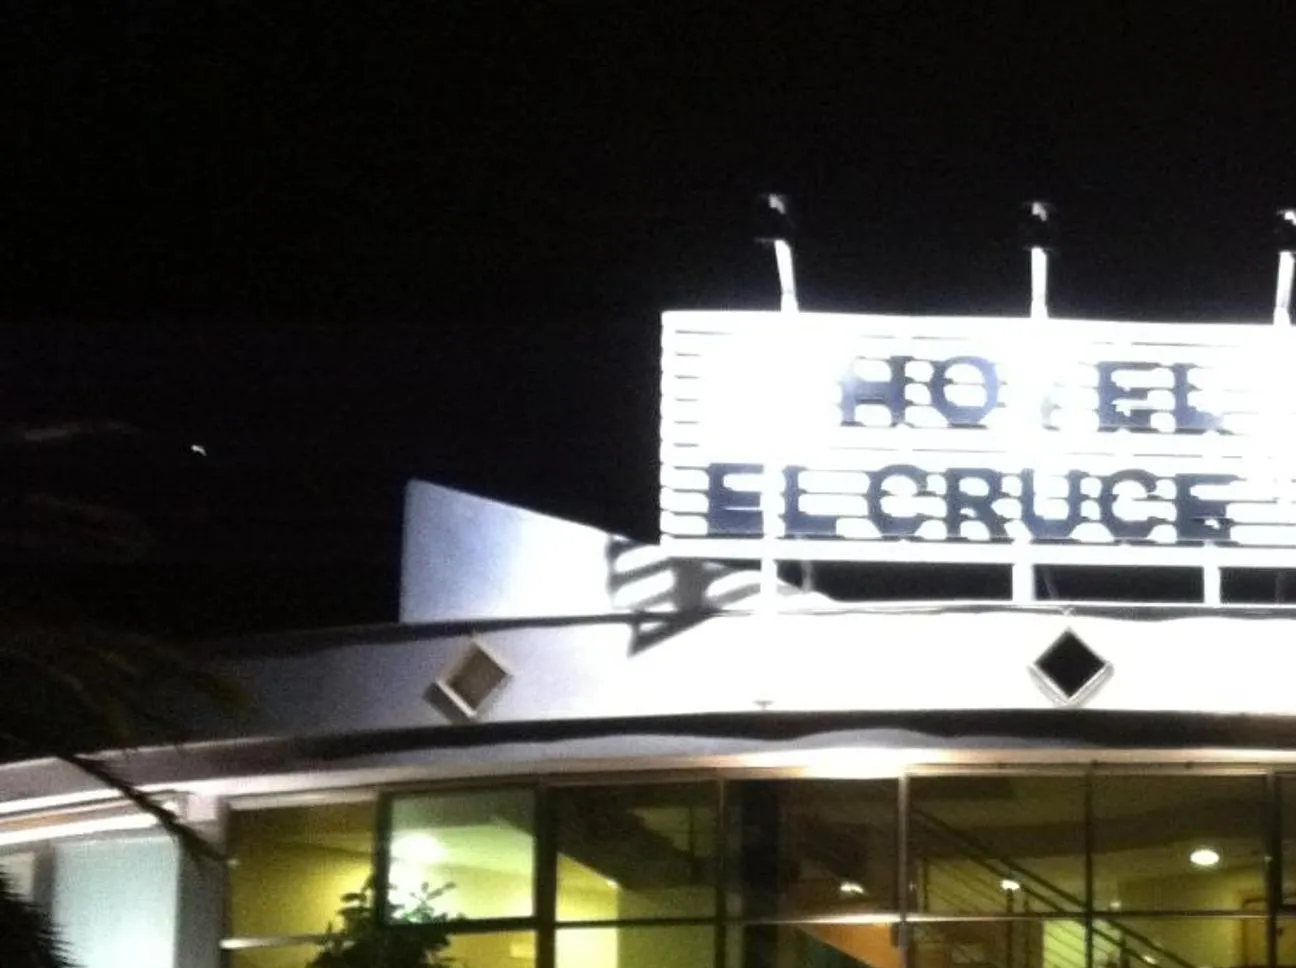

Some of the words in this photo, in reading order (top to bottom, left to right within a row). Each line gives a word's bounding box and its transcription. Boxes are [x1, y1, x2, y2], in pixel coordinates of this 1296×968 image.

[841, 356, 1226, 433] HOEL
[707, 463, 837, 539] EL
[867, 464, 1240, 546] CRUCE
